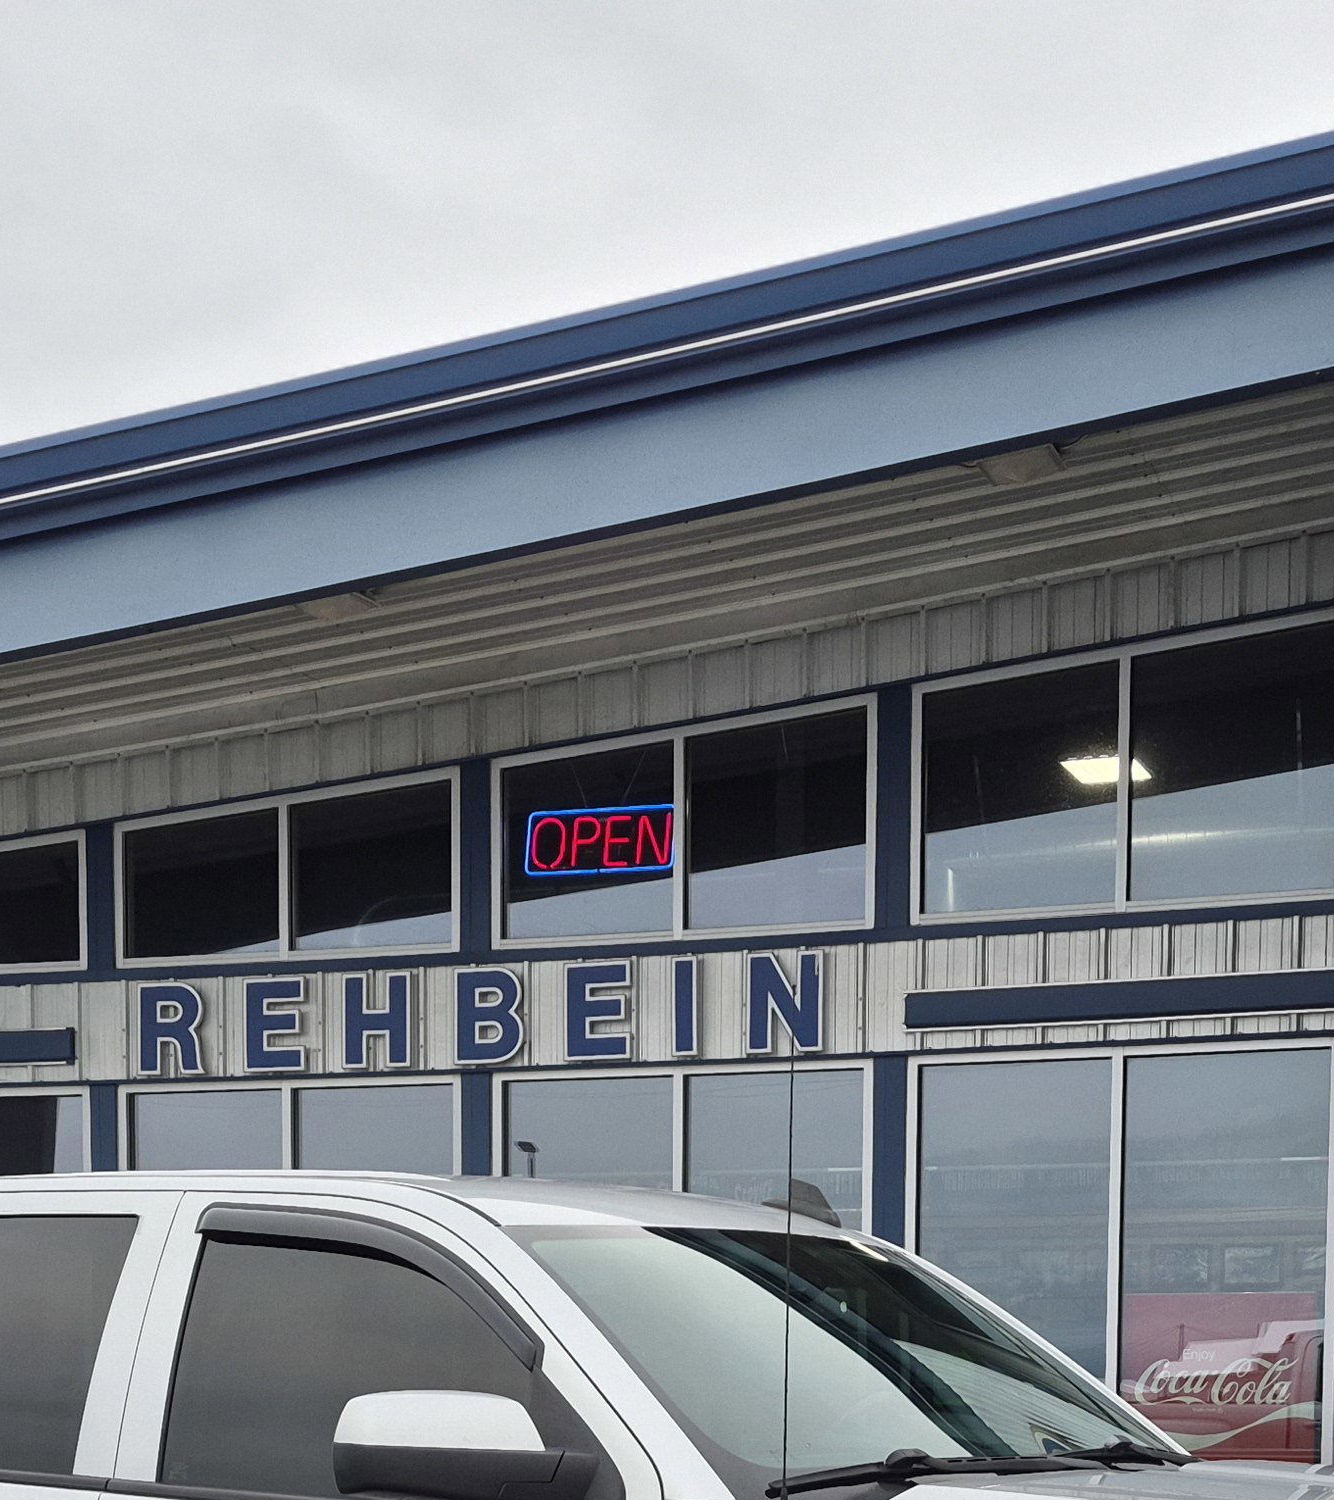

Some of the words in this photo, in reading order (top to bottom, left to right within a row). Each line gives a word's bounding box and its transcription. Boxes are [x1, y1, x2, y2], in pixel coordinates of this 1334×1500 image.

[531, 812, 672, 870] OPEN
[137, 949, 825, 1075] REHBEIN
[1182, 1348, 1215, 1361] Enjoy
